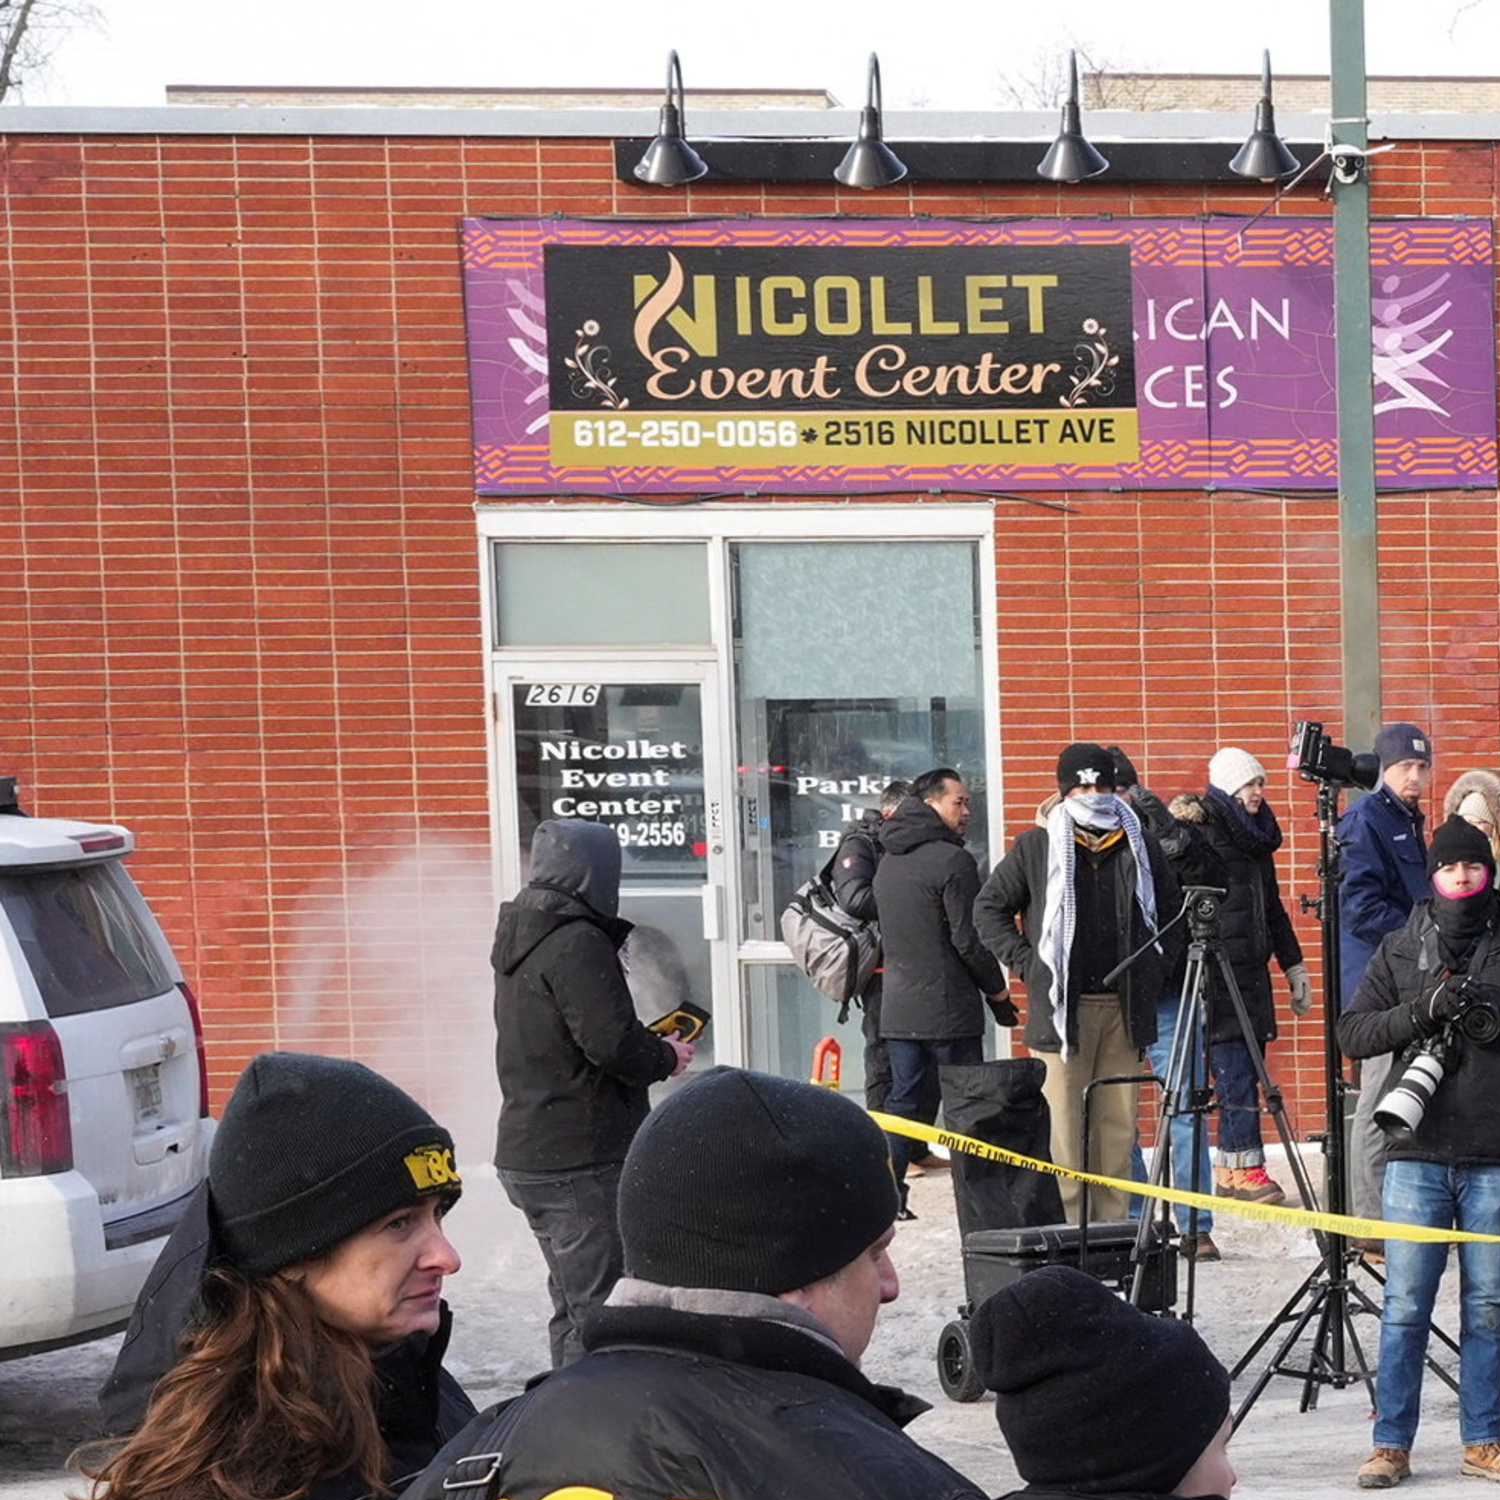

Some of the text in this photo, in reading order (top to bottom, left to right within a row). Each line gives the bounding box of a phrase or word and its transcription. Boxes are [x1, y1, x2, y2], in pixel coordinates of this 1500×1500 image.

[633, 274, 1059, 358] NICOLLET
[1133, 297, 1291, 341] ICAN
[645, 343, 1062, 401] Event Center
[573, 418, 1116, 448] 612-250-0056 2516 NICOLLET AVE
[529, 684, 599, 704] 2616
[540, 740, 687, 761] Nicollet
[560, 768, 671, 789] Event
[796, 775, 894, 796] Parki
[551, 797, 682, 817] Center
[937, 1133, 984, 1158] POLICE
[986, 1147, 1016, 1166] LINE
